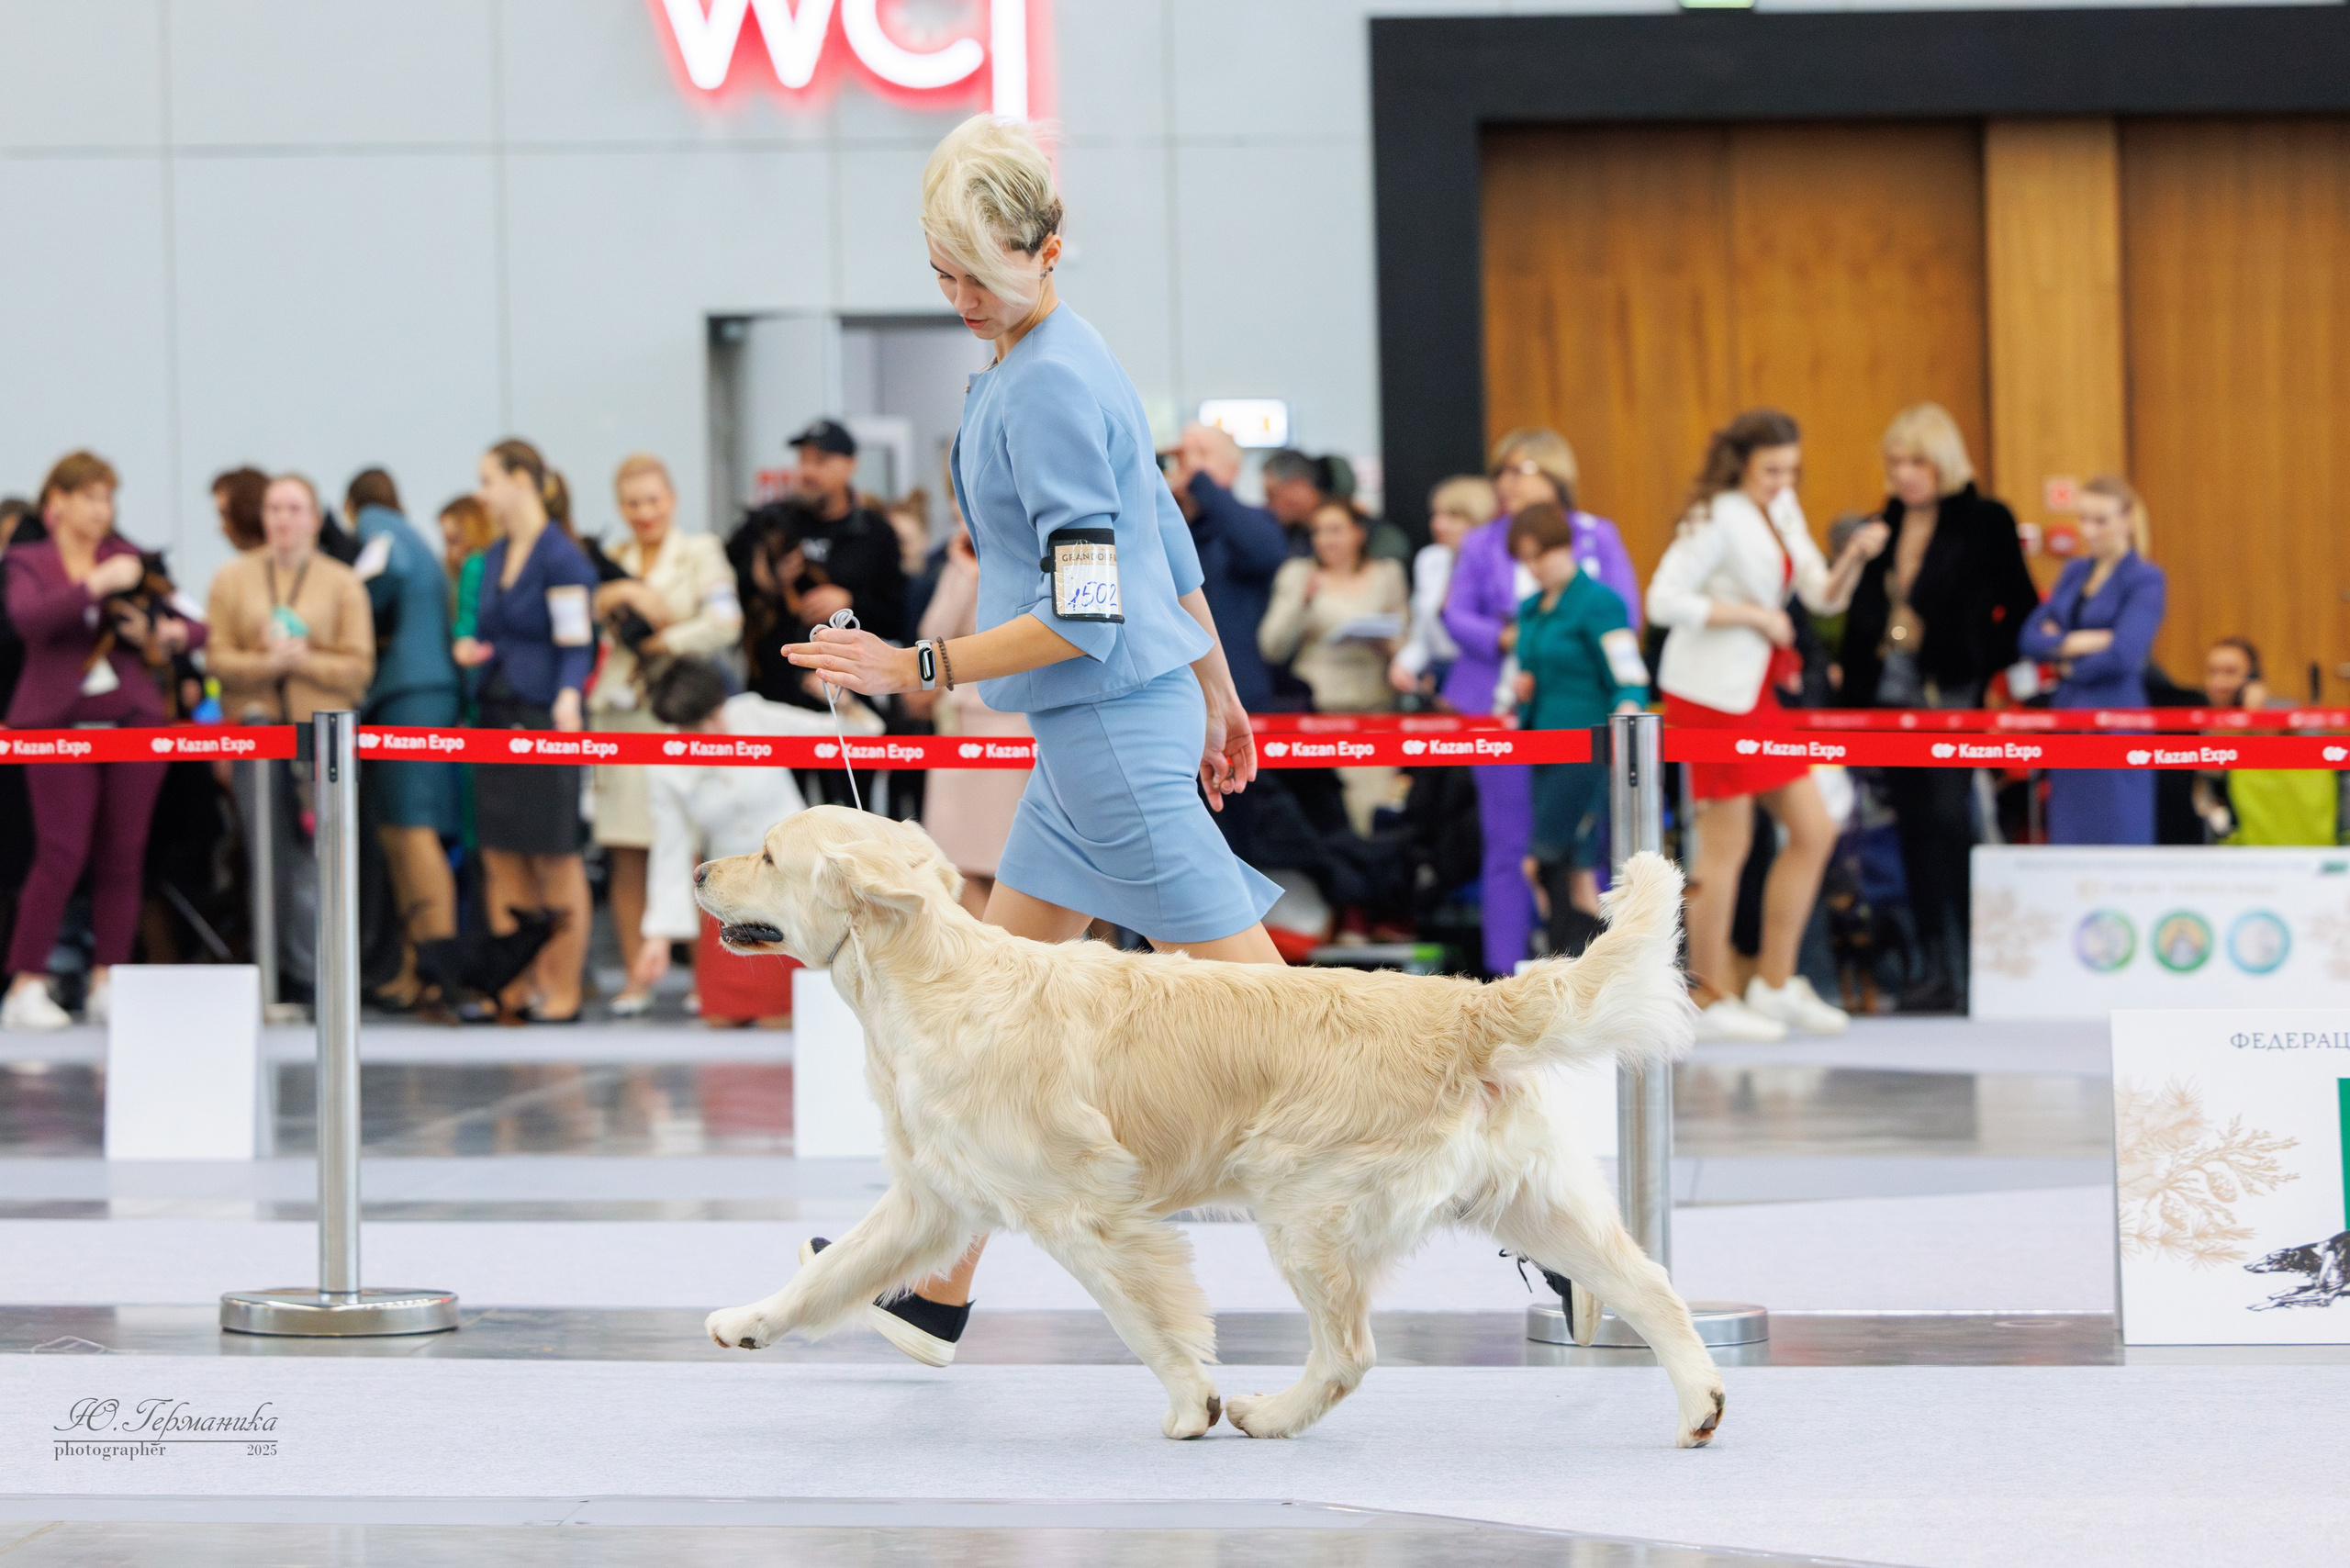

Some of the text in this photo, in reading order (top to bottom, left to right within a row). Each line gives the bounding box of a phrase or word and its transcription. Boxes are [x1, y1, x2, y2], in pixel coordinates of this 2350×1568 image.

[13, 739, 92, 756] Kazan Expo
[177, 736, 255, 754] Kazan Expo
[383, 734, 465, 753] Kazan Expo
[536, 740, 619, 758] Kazan Expo
[689, 741, 773, 759] Kazan Expo
[842, 743, 924, 762] Kazan Expo
[985, 743, 1030, 758] Kazan
[1292, 741, 1375, 759] Kazan Expo
[1429, 739, 1513, 757] Kazan Expo
[1762, 741, 1846, 760] Kazan Expo
[1958, 743, 2042, 761] Kazan Expo
[2154, 747, 2238, 765] Kazan Expo
